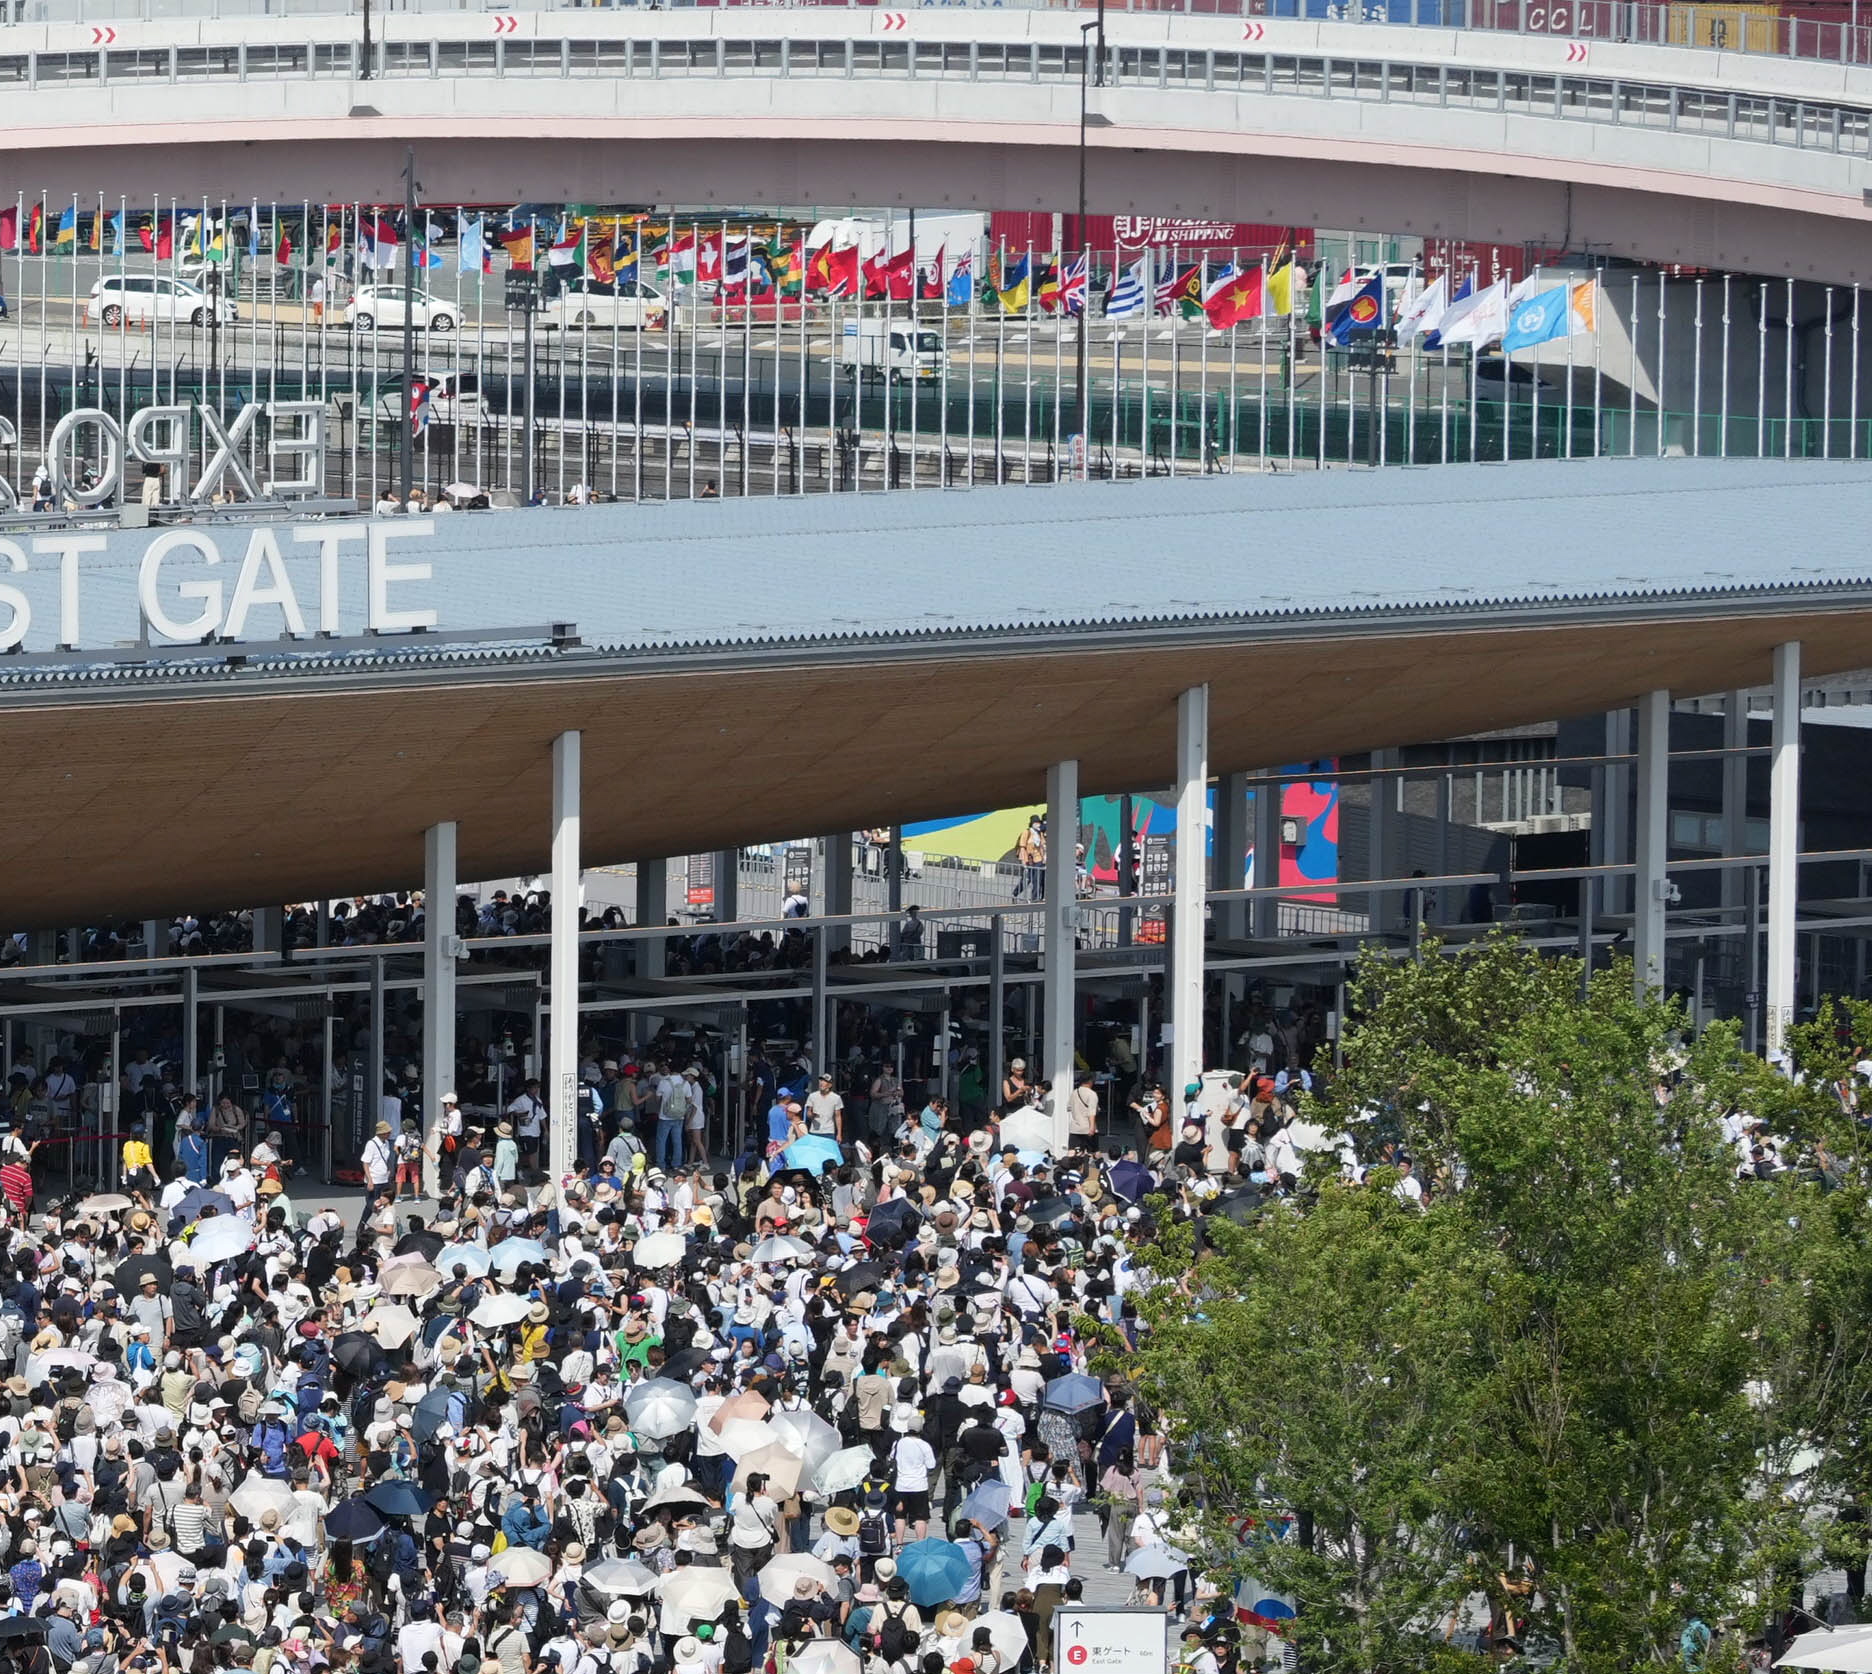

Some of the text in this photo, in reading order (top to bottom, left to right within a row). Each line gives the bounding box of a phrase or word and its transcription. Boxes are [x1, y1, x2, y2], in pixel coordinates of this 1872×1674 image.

[1169, 228, 1235, 241] SHIPPING
[138, 519, 439, 640] GATE
[1073, 1651, 1082, 1660] E
[1092, 1647, 1131, 1656] 東ゲート
